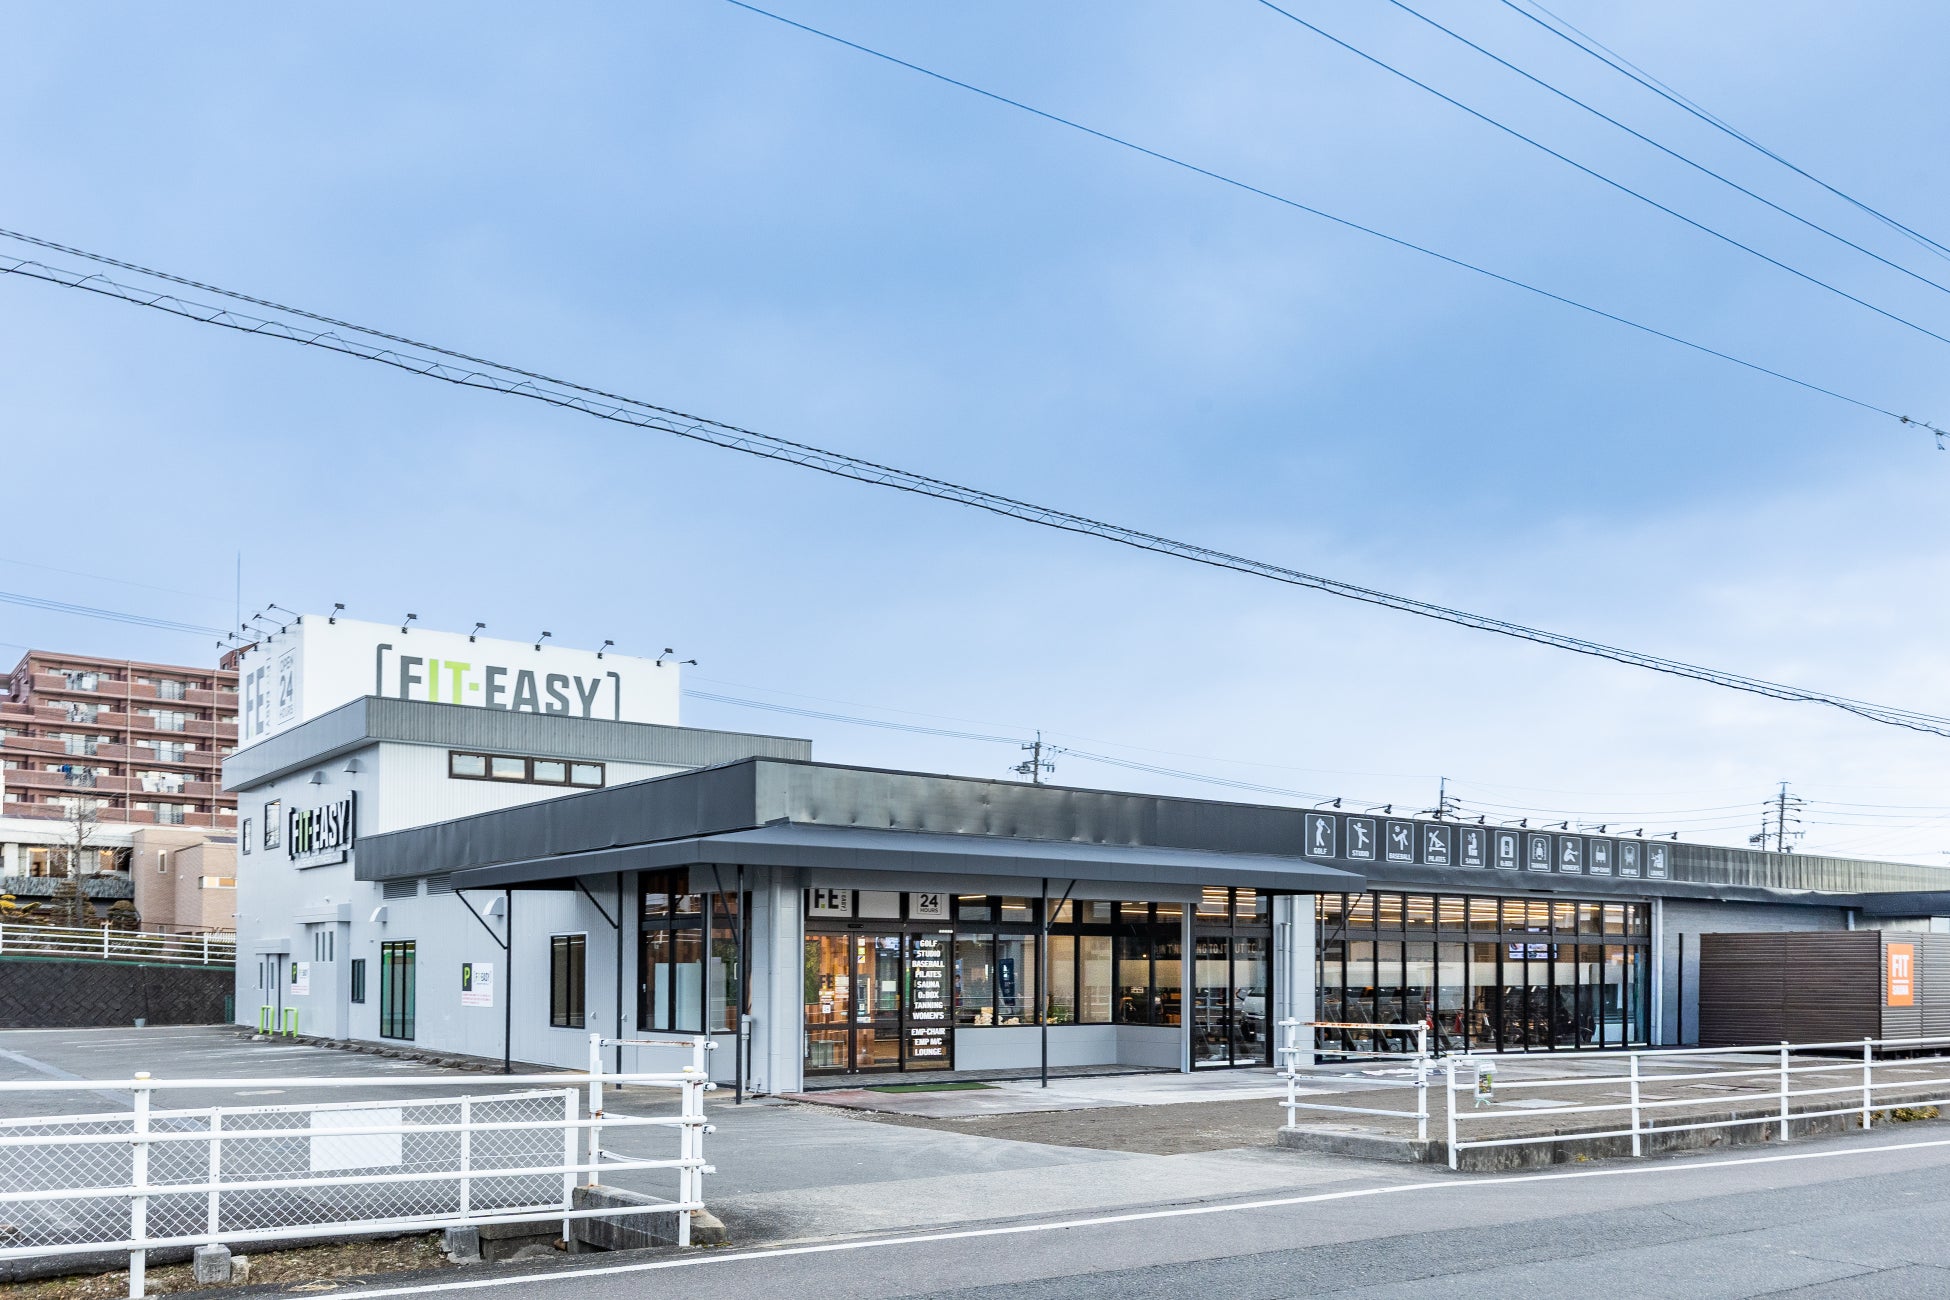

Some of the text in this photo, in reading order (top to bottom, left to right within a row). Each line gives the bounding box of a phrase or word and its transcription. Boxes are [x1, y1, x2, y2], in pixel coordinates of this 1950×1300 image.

[280, 671, 293, 707] 24
[1314, 847, 1328, 855] GOLF
[1352, 849, 1370, 857] STUDIO
[1389, 852, 1412, 860] BASEBALL
[1428, 855, 1447, 863] PILATES
[920, 894, 939, 907] 24
[912, 960, 945, 968] BASEBALL
[1892, 955, 1910, 978] FIT
[463, 966, 471, 987] P
[915, 970, 942, 978] PILATES
[917, 980, 940, 988] SAUNA
[914, 1001, 944, 1009] TANNING
[912, 1012, 945, 1020] WOMEN'S
[911, 1028, 946, 1036] EMP-CHAIR
[915, 1038, 929, 1046] EMP
[915, 1048, 942, 1056] LOUNGE
